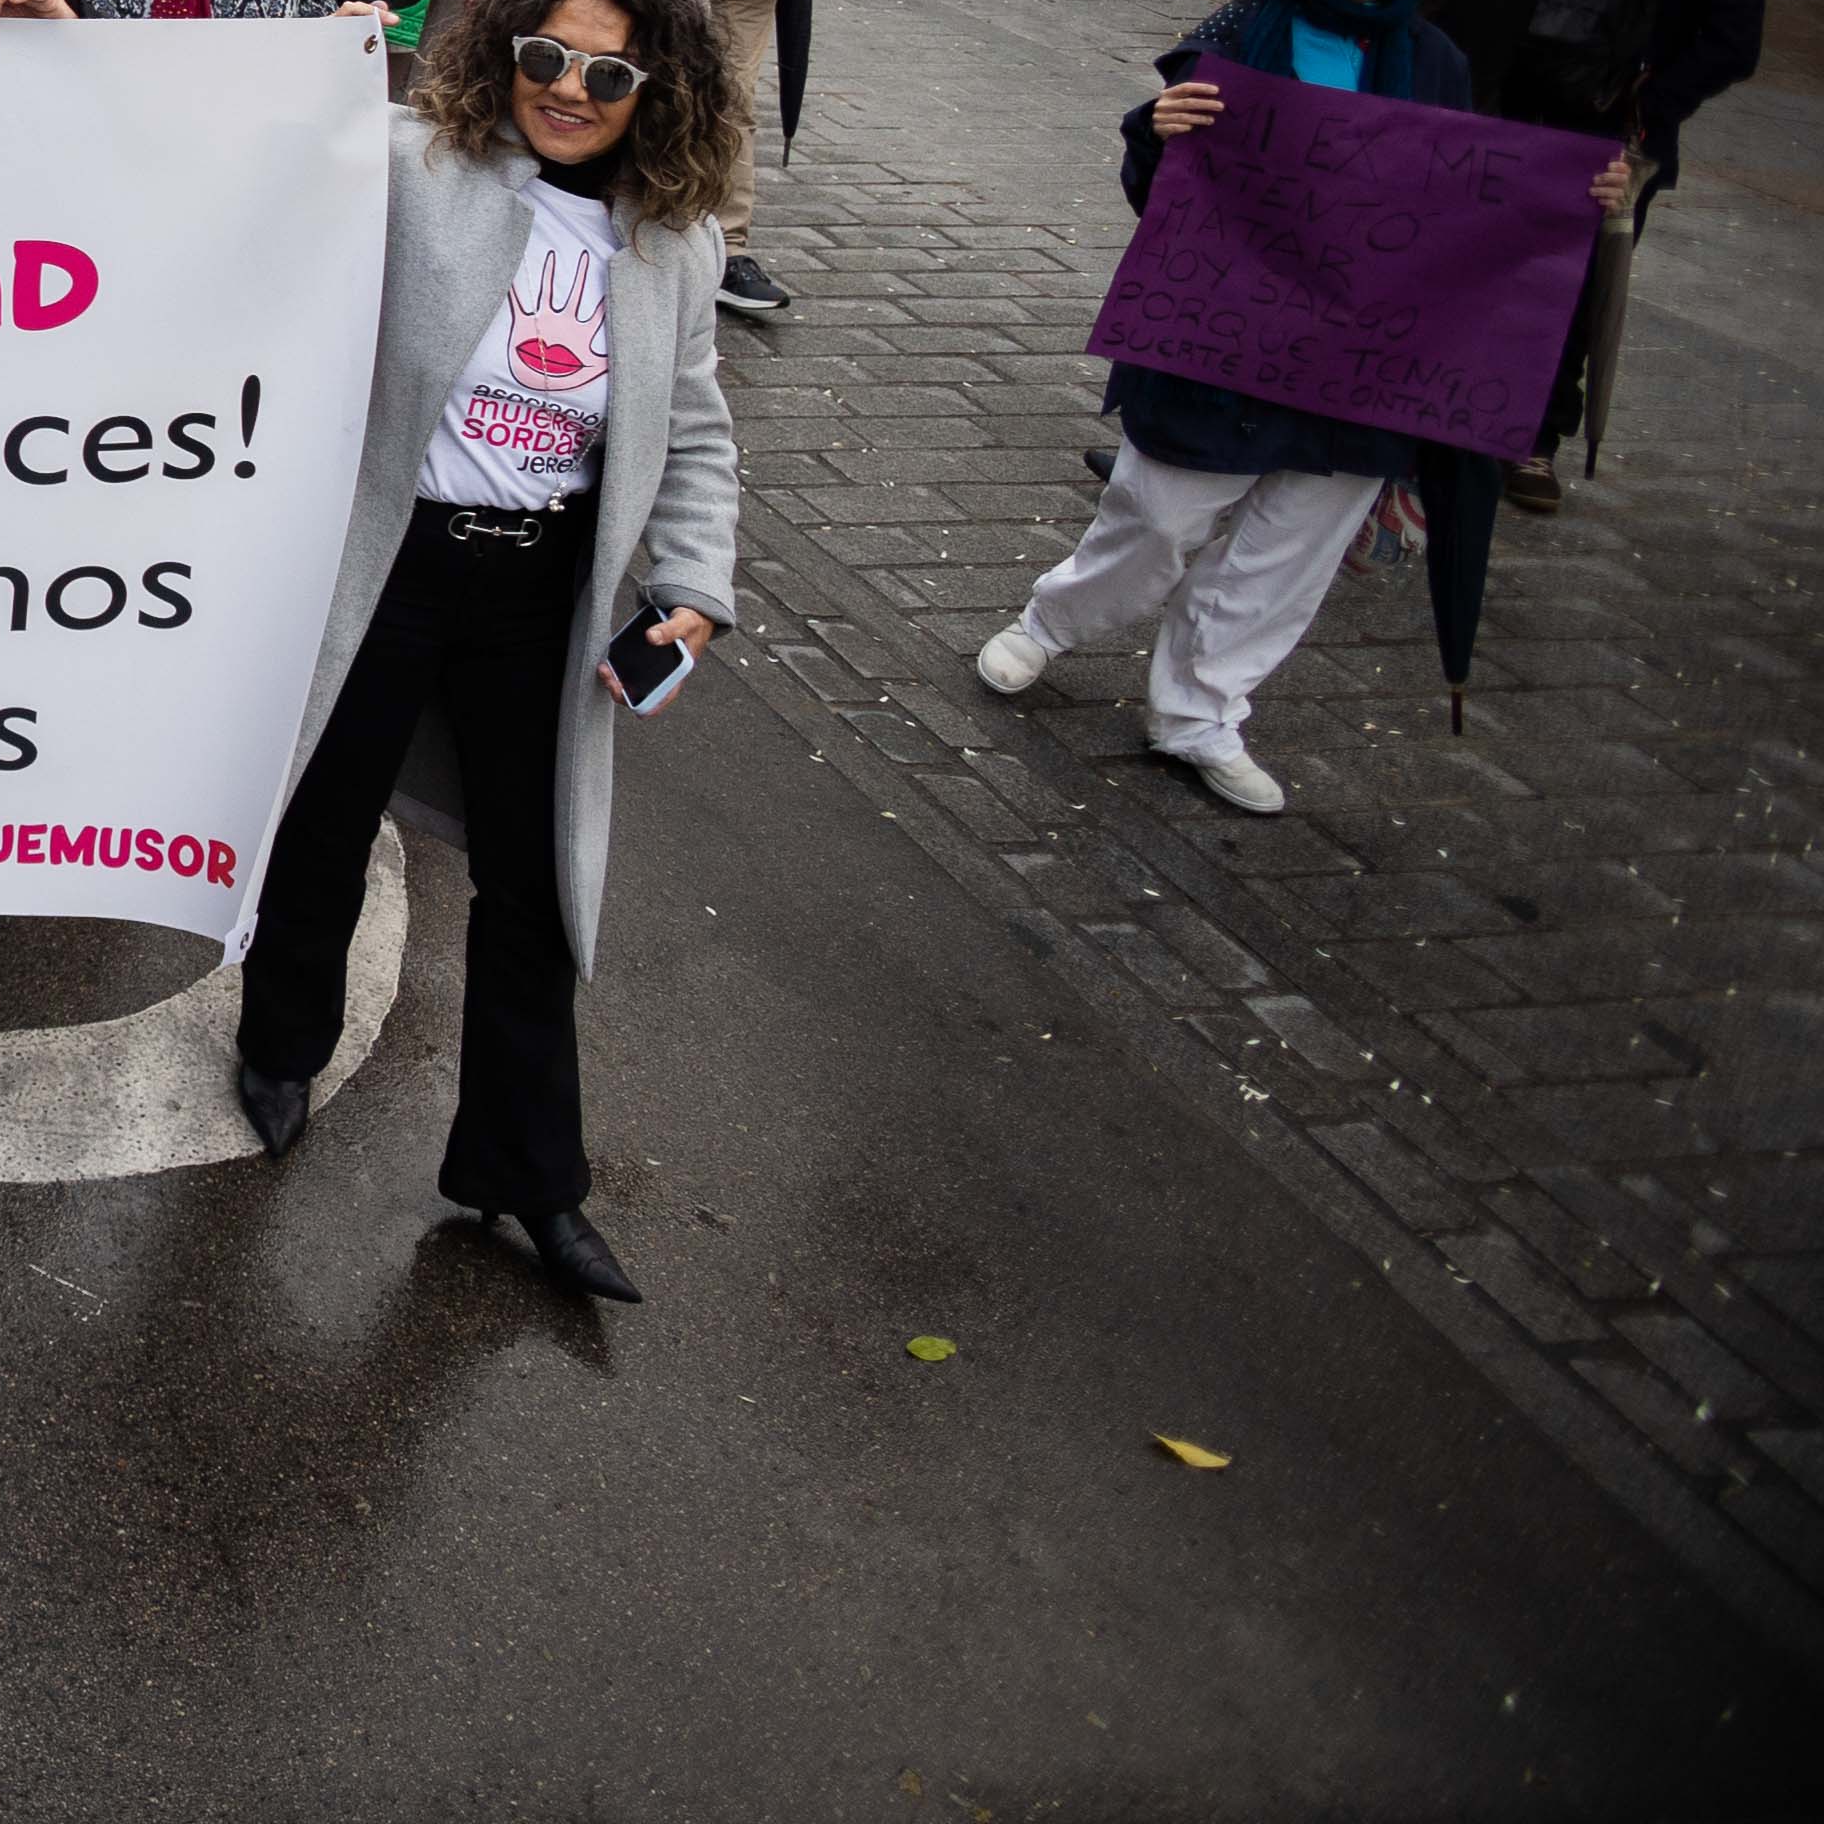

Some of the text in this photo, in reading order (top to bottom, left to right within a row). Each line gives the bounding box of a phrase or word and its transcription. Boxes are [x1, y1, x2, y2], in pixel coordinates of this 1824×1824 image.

[1305, 116, 1390, 179] EX
[1424, 139, 1522, 204] ME
[1154, 197, 1353, 290] MATAR
[1136, 243, 1420, 340] HOY SALGO
[1256, 364, 1303, 393] DE
[1319, 380, 1535, 454] CONTARLO
